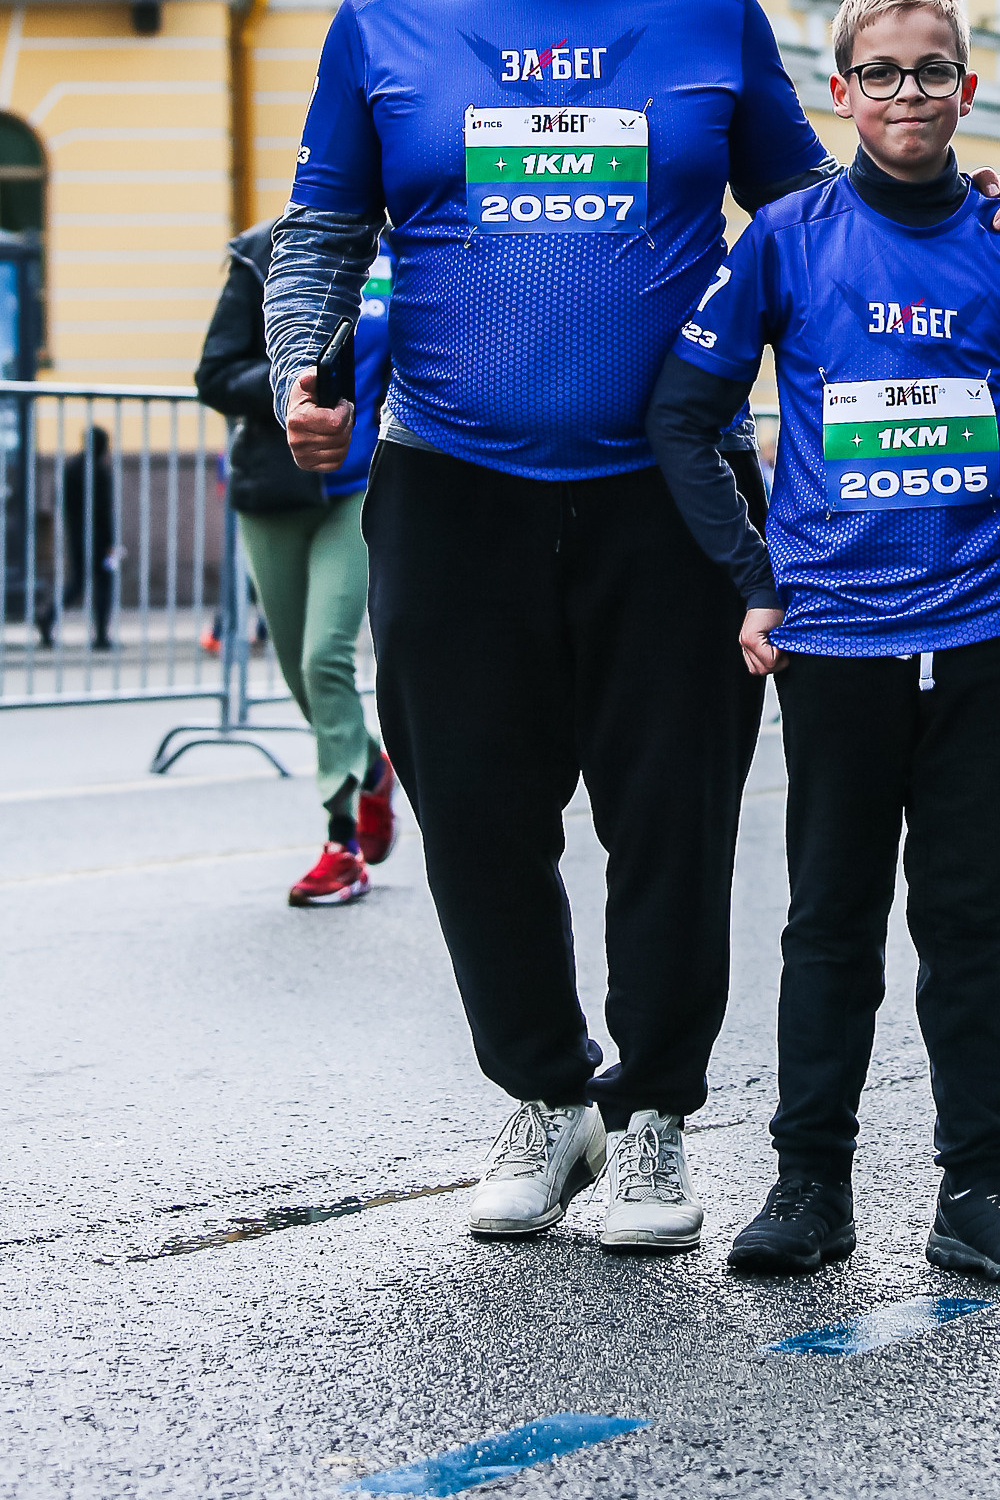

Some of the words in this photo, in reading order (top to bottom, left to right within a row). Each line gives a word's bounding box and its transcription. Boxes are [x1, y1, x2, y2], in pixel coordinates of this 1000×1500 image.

[484, 121, 503, 129] ПСБ
[481, 194, 635, 222] 20507
[681, 321, 718, 349] 23
[840, 396, 857, 404] ПСБ
[839, 465, 989, 500] 20505
